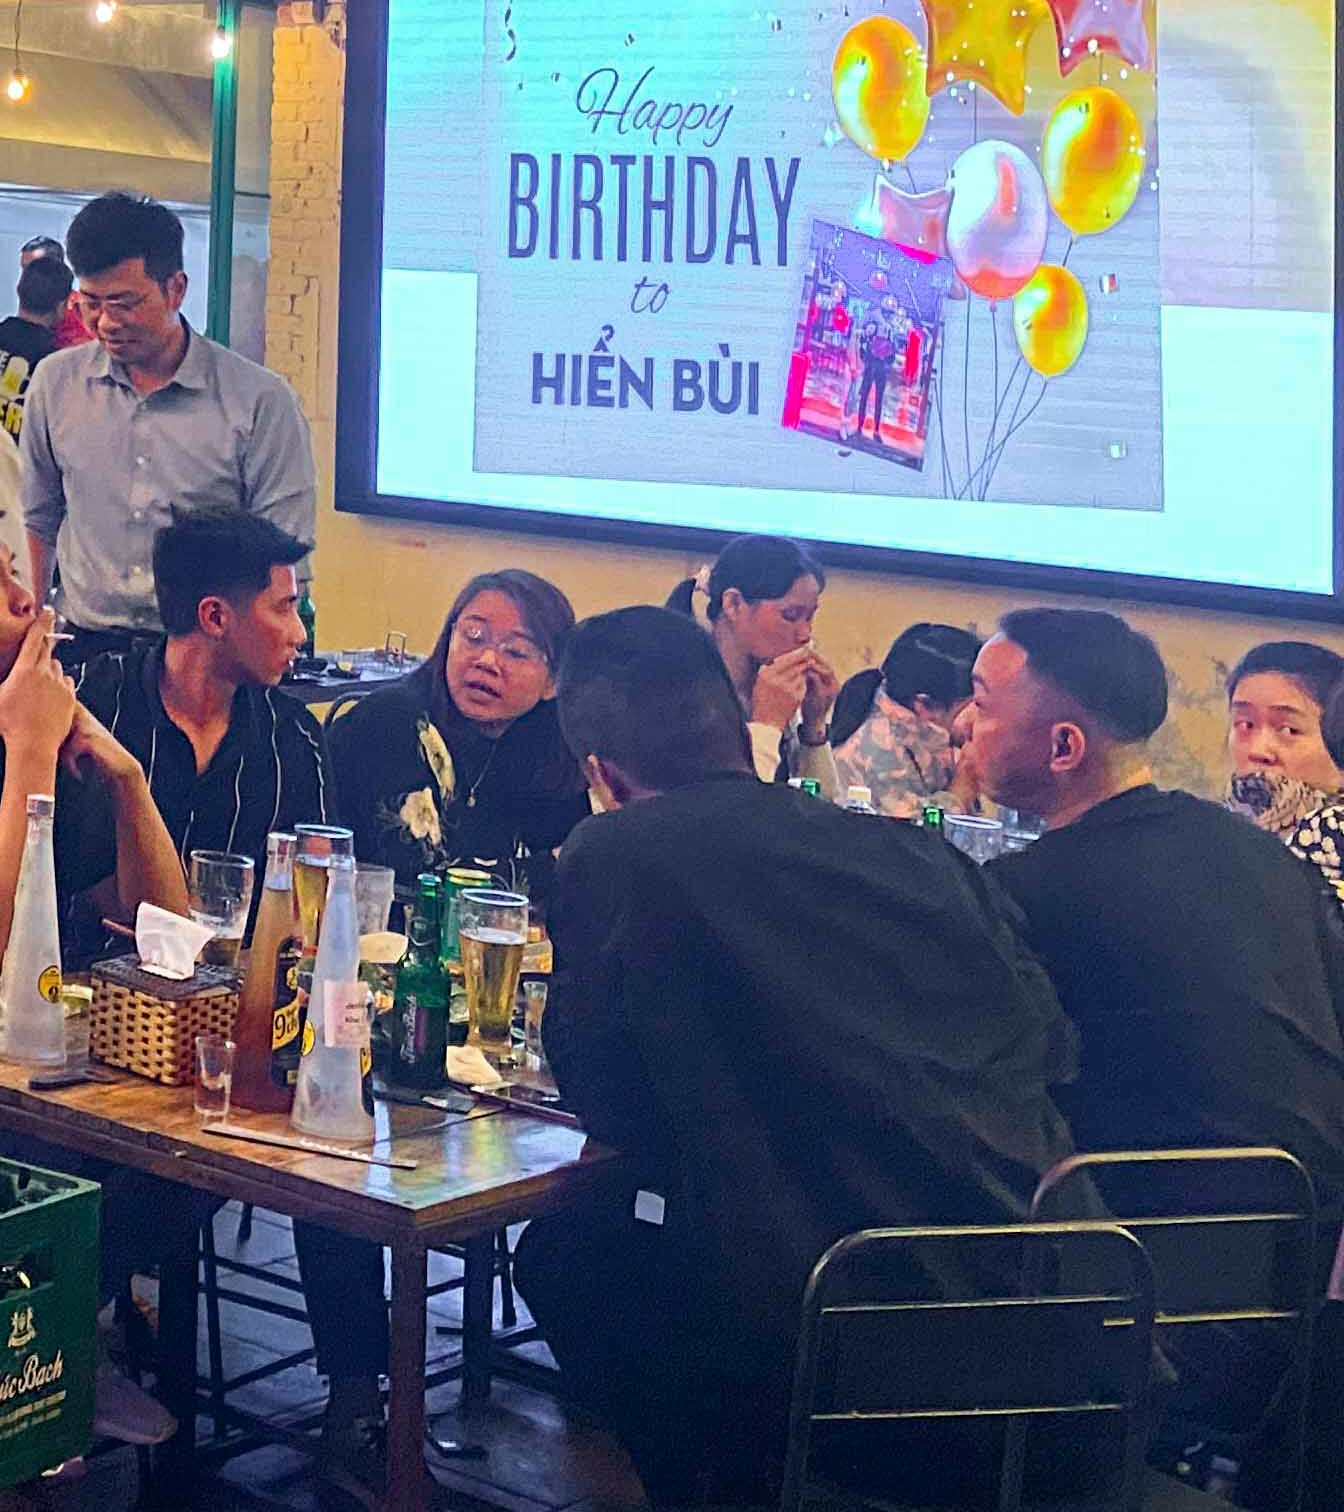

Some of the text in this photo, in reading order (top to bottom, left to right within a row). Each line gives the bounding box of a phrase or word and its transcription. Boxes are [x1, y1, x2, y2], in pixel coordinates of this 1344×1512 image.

[576, 65, 734, 148] Happy
[508, 153, 801, 269] BIRTHDAY
[632, 276, 670, 315] to
[531, 324, 761, 418] HIỂN BÙI
